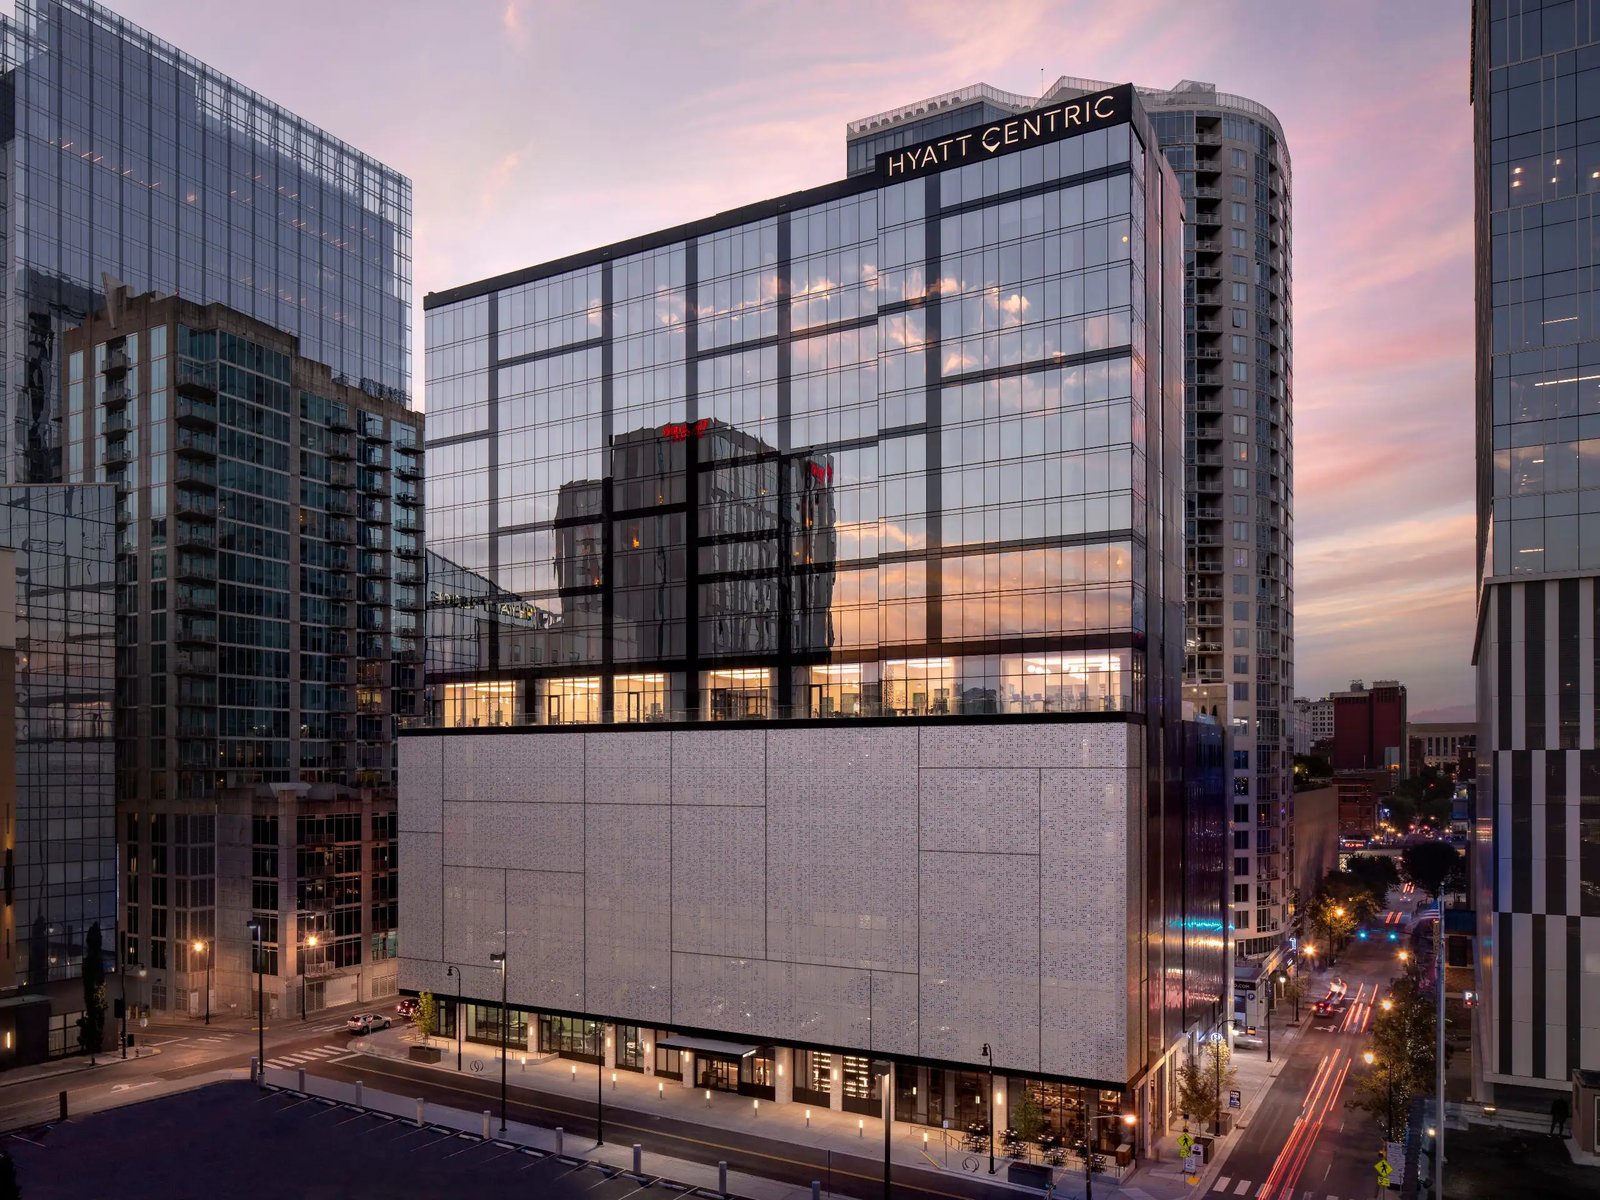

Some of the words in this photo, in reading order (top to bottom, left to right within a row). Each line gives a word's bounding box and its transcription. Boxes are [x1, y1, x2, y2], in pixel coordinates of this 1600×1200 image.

[889, 134, 972, 176] HYATT
[982, 95, 1114, 152] CENTRIC
[1465, 992, 1473, 1000] P
